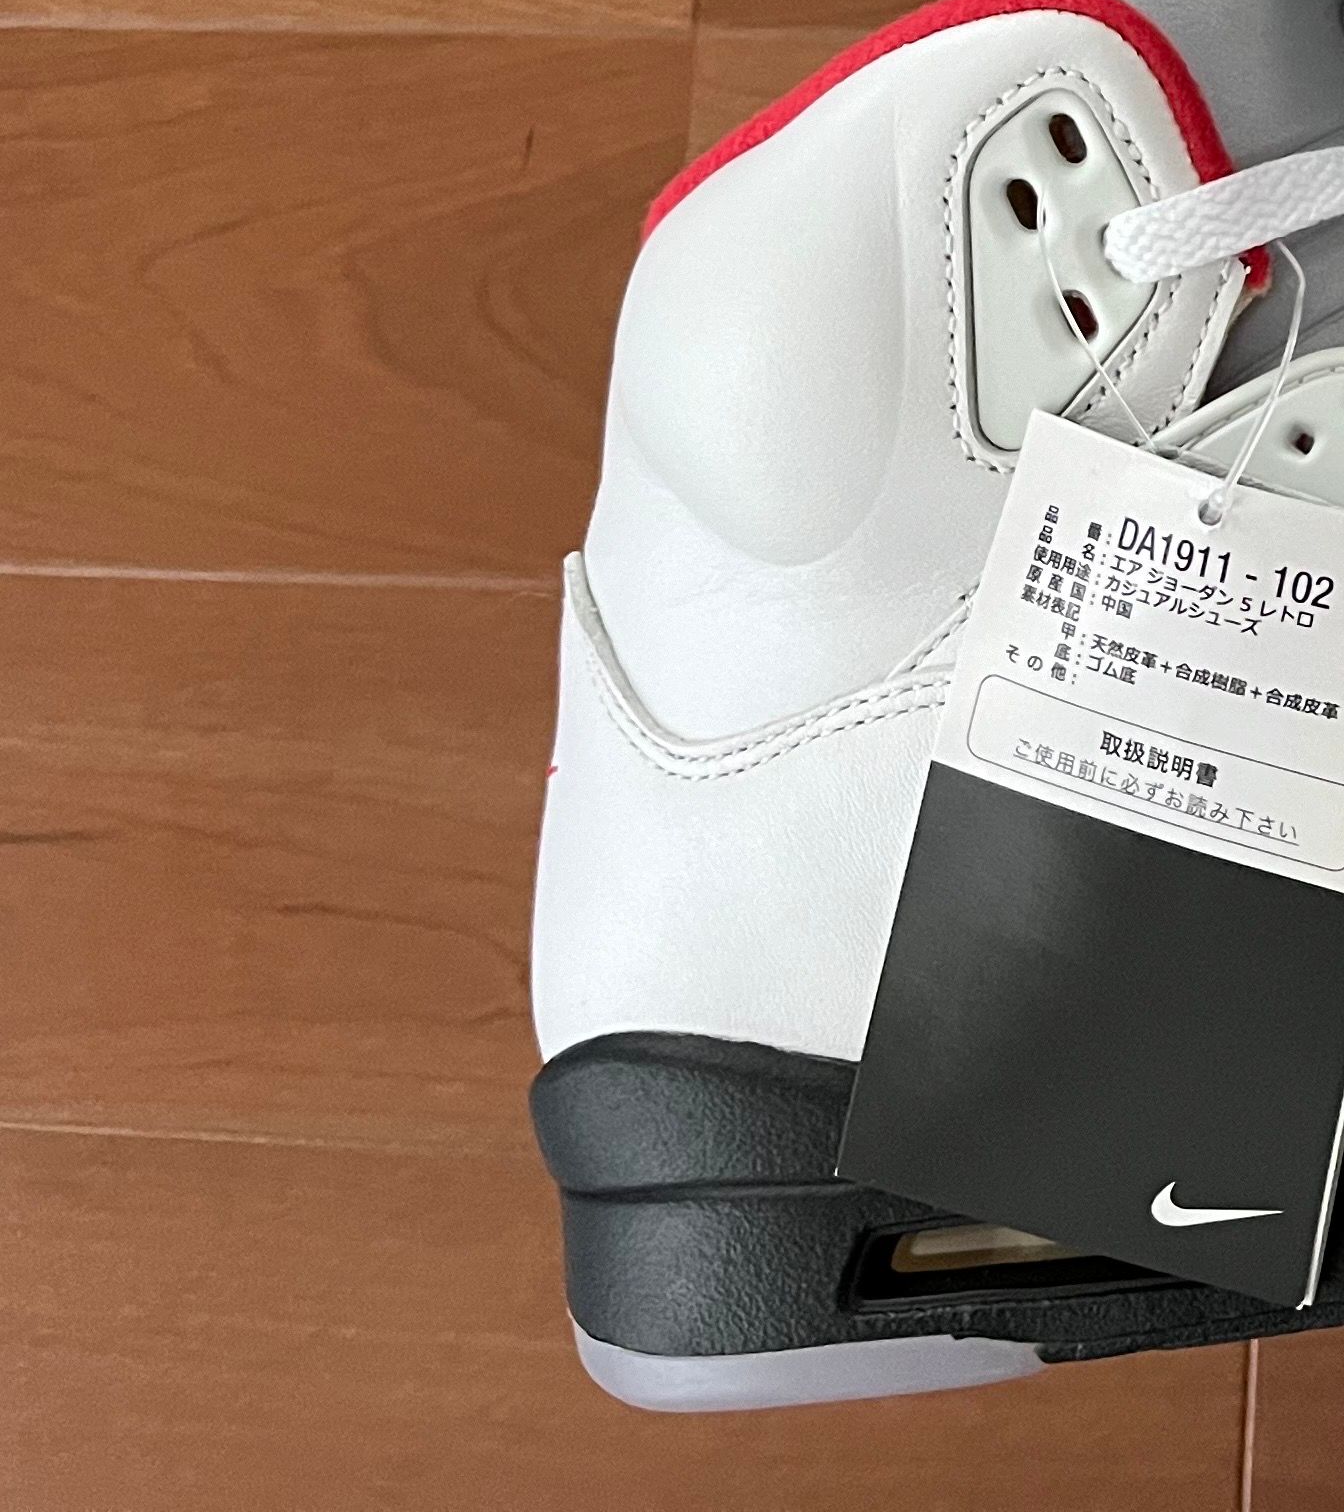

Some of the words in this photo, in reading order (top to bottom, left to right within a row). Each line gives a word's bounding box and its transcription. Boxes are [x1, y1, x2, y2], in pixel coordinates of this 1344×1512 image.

[1109, 554, 1144, 579] エア
[1147, 567, 1235, 607] ジョーダン
[1241, 597, 1251, 612] 5
[1259, 601, 1315, 628] レトロ
[1118, 516, 1231, 584] DA1911
[1273, 566, 1335, 610] 102
[1020, 584, 1080, 622] 素材表記
[1101, 595, 1133, 619] 中国
[1104, 575, 1259, 636] カジュアルシューズ
[1085, 653, 1137, 685] ゴム底
[1100, 730, 1218, 788] 取扱説明書
[1014, 737, 1299, 841] ご使用前に必ずお読み下さい
